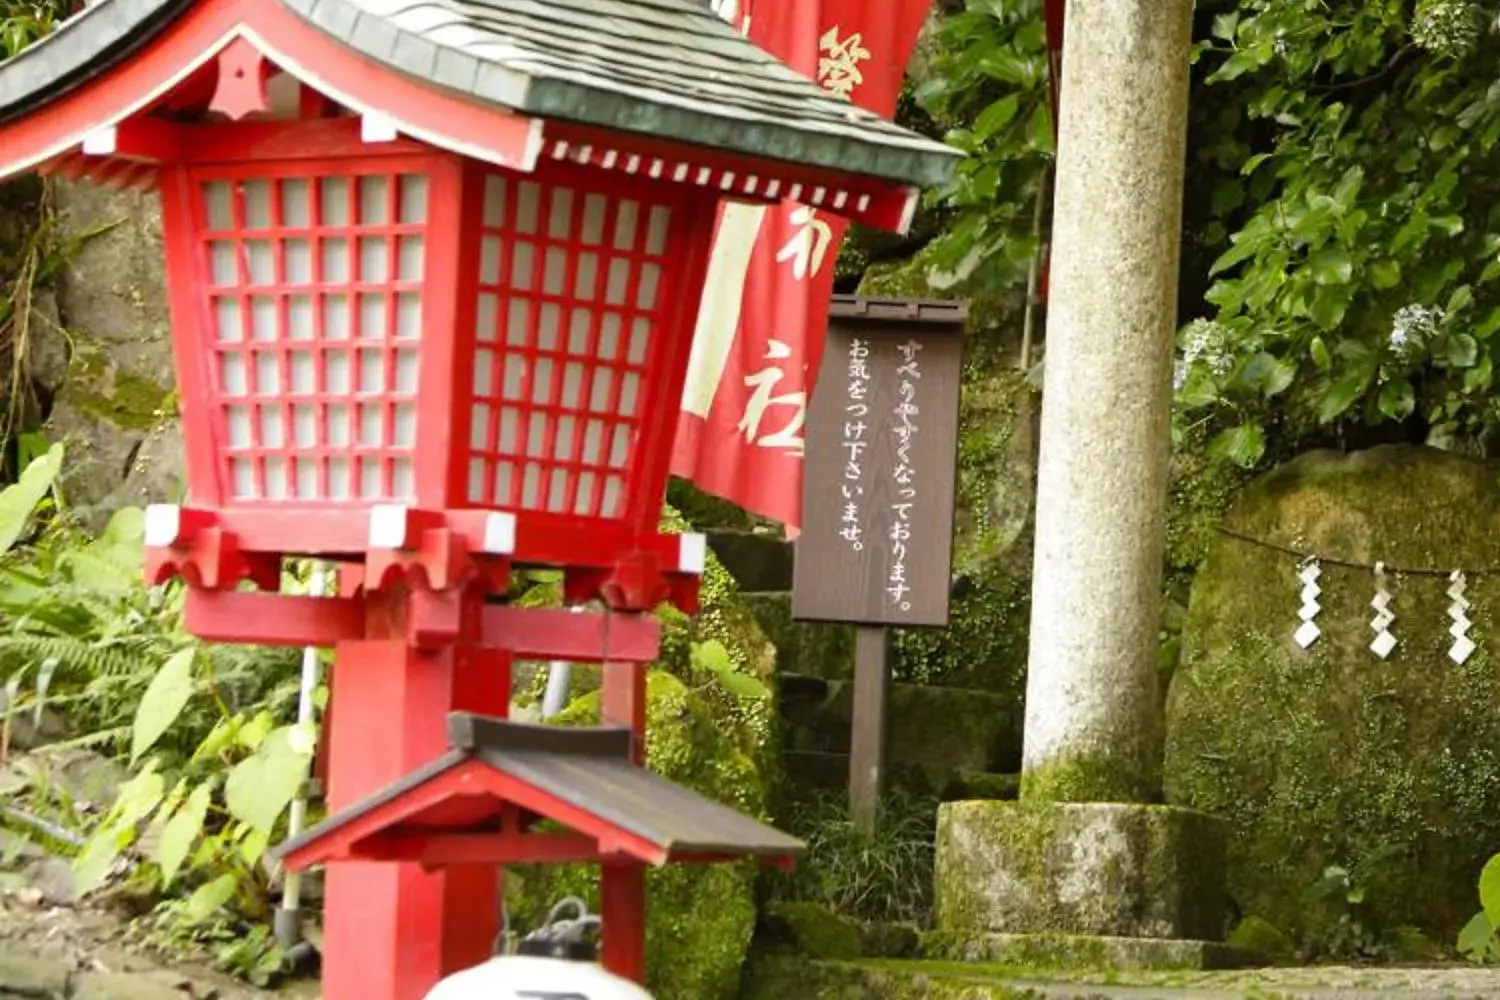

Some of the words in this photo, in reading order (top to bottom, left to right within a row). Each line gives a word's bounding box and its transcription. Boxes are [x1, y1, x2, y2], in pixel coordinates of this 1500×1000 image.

[839, 339, 870, 551] お気をつけ下さいませ。
